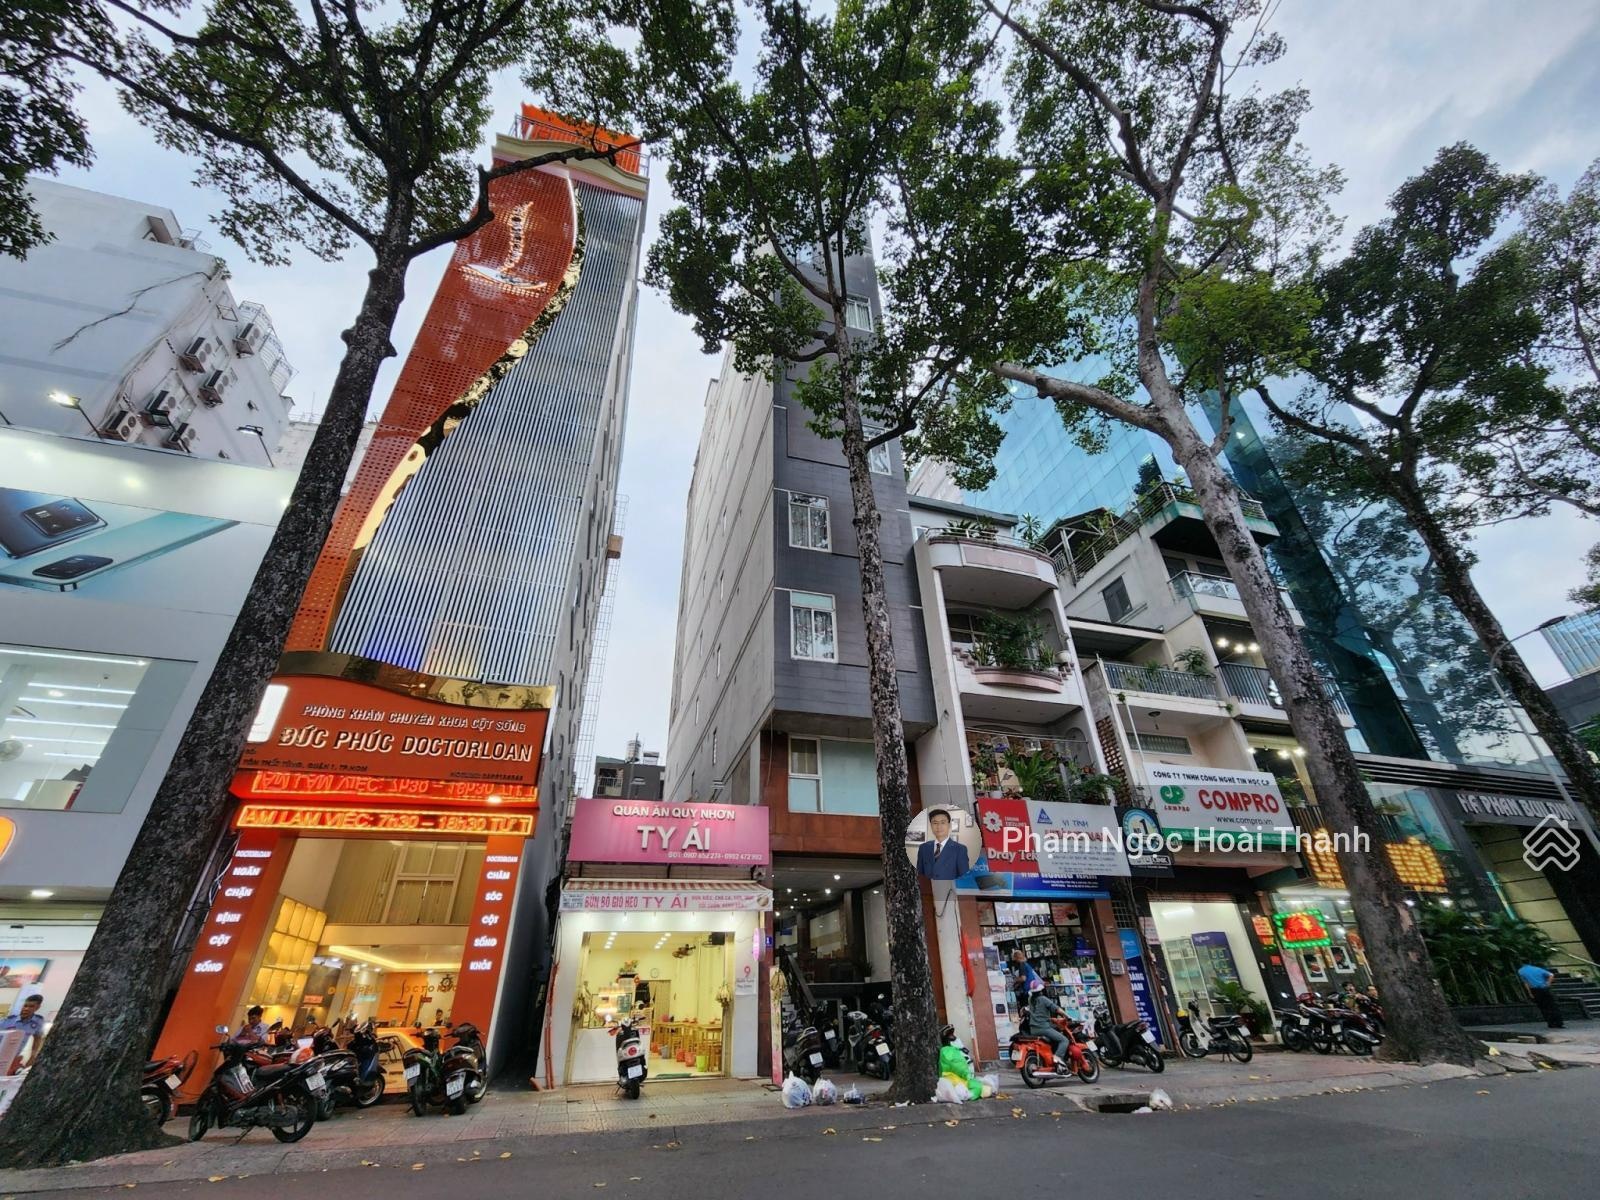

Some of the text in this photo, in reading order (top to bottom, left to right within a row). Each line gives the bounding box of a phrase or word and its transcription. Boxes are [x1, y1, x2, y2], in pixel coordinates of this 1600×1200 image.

[303, 704, 527, 732] PHÒNG KHÁM CHUYÊN KHOA CỘT SỐNG
[278, 724, 533, 763] ĐỨC PHÚC DOCTORLOAN
[1172, 772, 1181, 780] TY
[1182, 773, 1200, 781] TNHH
[1236, 777, 1248, 785] TIN
[1198, 789, 1280, 814] COMPRO
[1518, 799, 1578, 821] BUILDIN
[378, 813, 419, 829] 7h30
[1215, 815, 1274, 826] www.compro.vn
[637, 822, 711, 851] TY ÁI
[987, 847, 1015, 863] Dray
[232, 865, 262, 876] NGĂN
[486, 870, 511, 880] CHĂM
[224, 886, 255, 899] CHẶN
[485, 890, 503, 901] SÓC
[642, 896, 665, 909] TY
[670, 892, 687, 909] ÁI
[216, 911, 242, 924] BỆNH
[481, 913, 500, 925] CỘT
[209, 934, 232, 947] CỘT
[474, 935, 497, 947] SỐNG
[194, 959, 224, 973] SỐNG
[69, 1006, 90, 1019] 25
